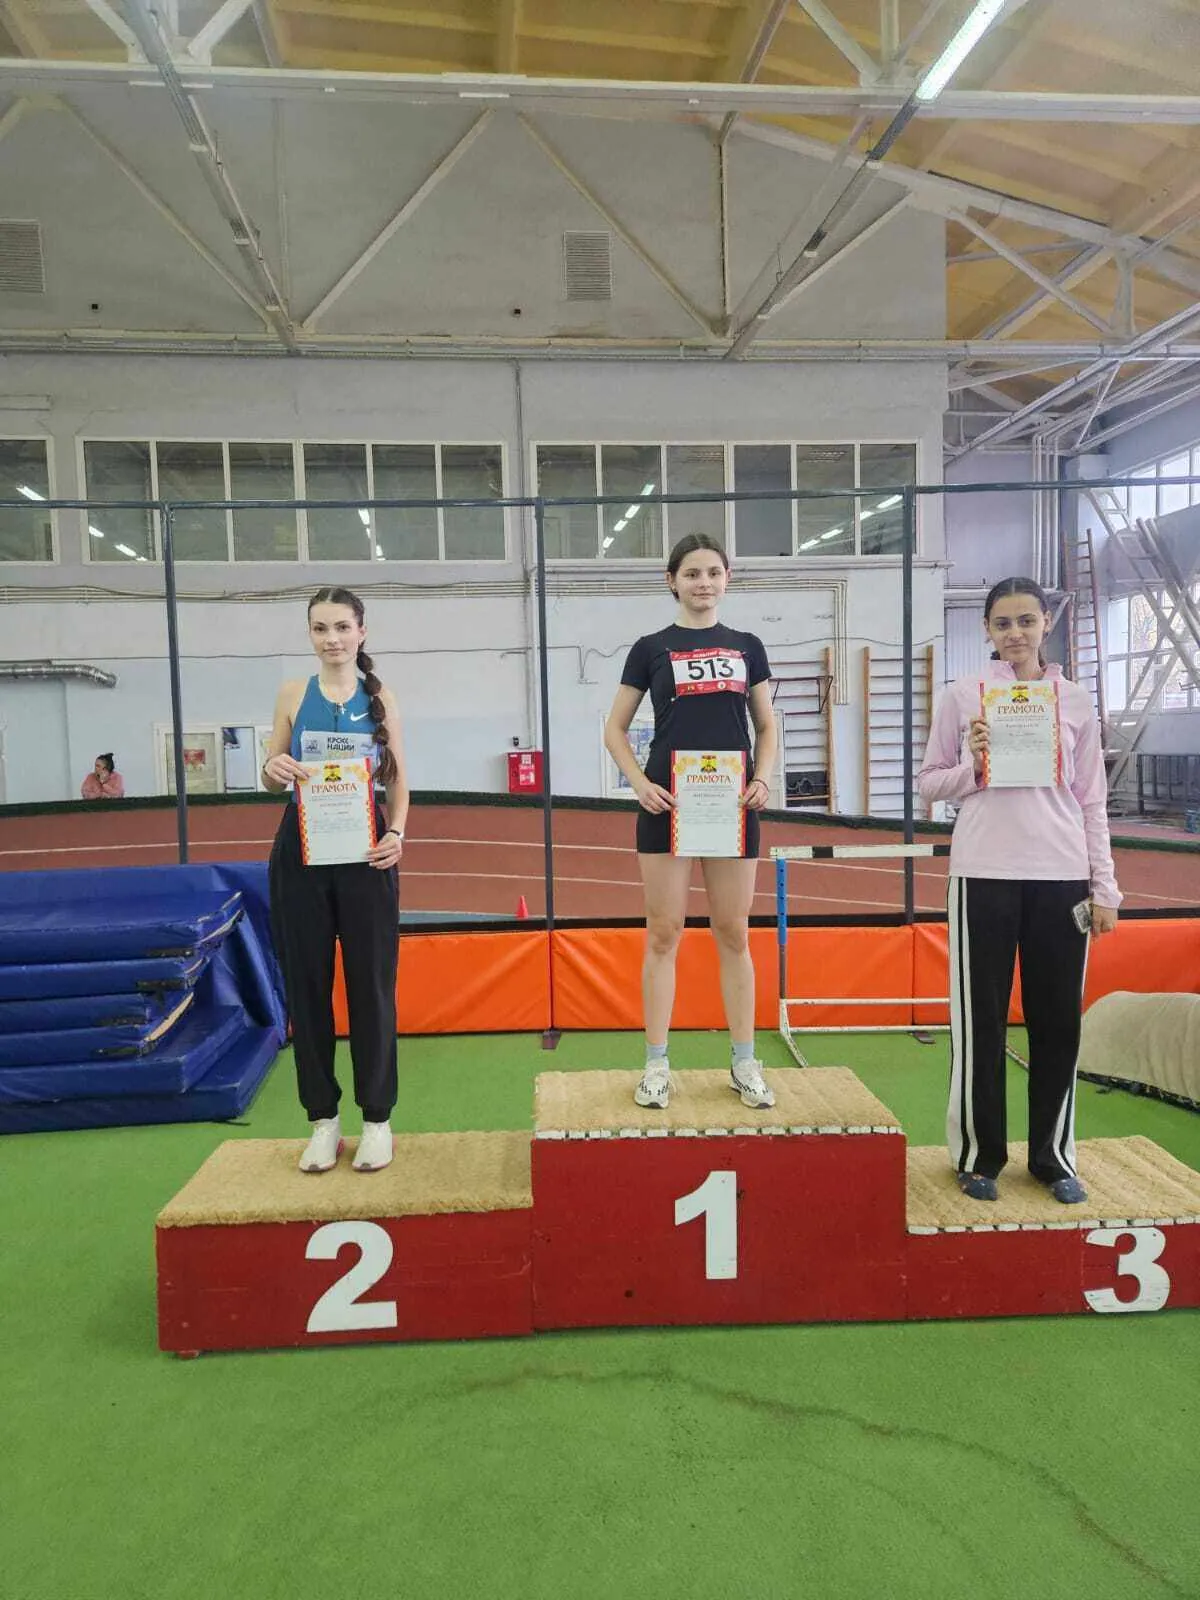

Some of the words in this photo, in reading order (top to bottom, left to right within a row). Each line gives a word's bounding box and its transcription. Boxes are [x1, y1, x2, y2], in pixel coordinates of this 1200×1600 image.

[688, 658, 734, 680] 513
[998, 705, 1045, 714] ГРАМОТА
[311, 783, 357, 794] ГРАМОТА
[687, 775, 731, 783] ГРАМОТА
[674, 1170, 737, 1280] 1
[305, 1220, 398, 1332] 2
[1084, 1227, 1170, 1313] 3
